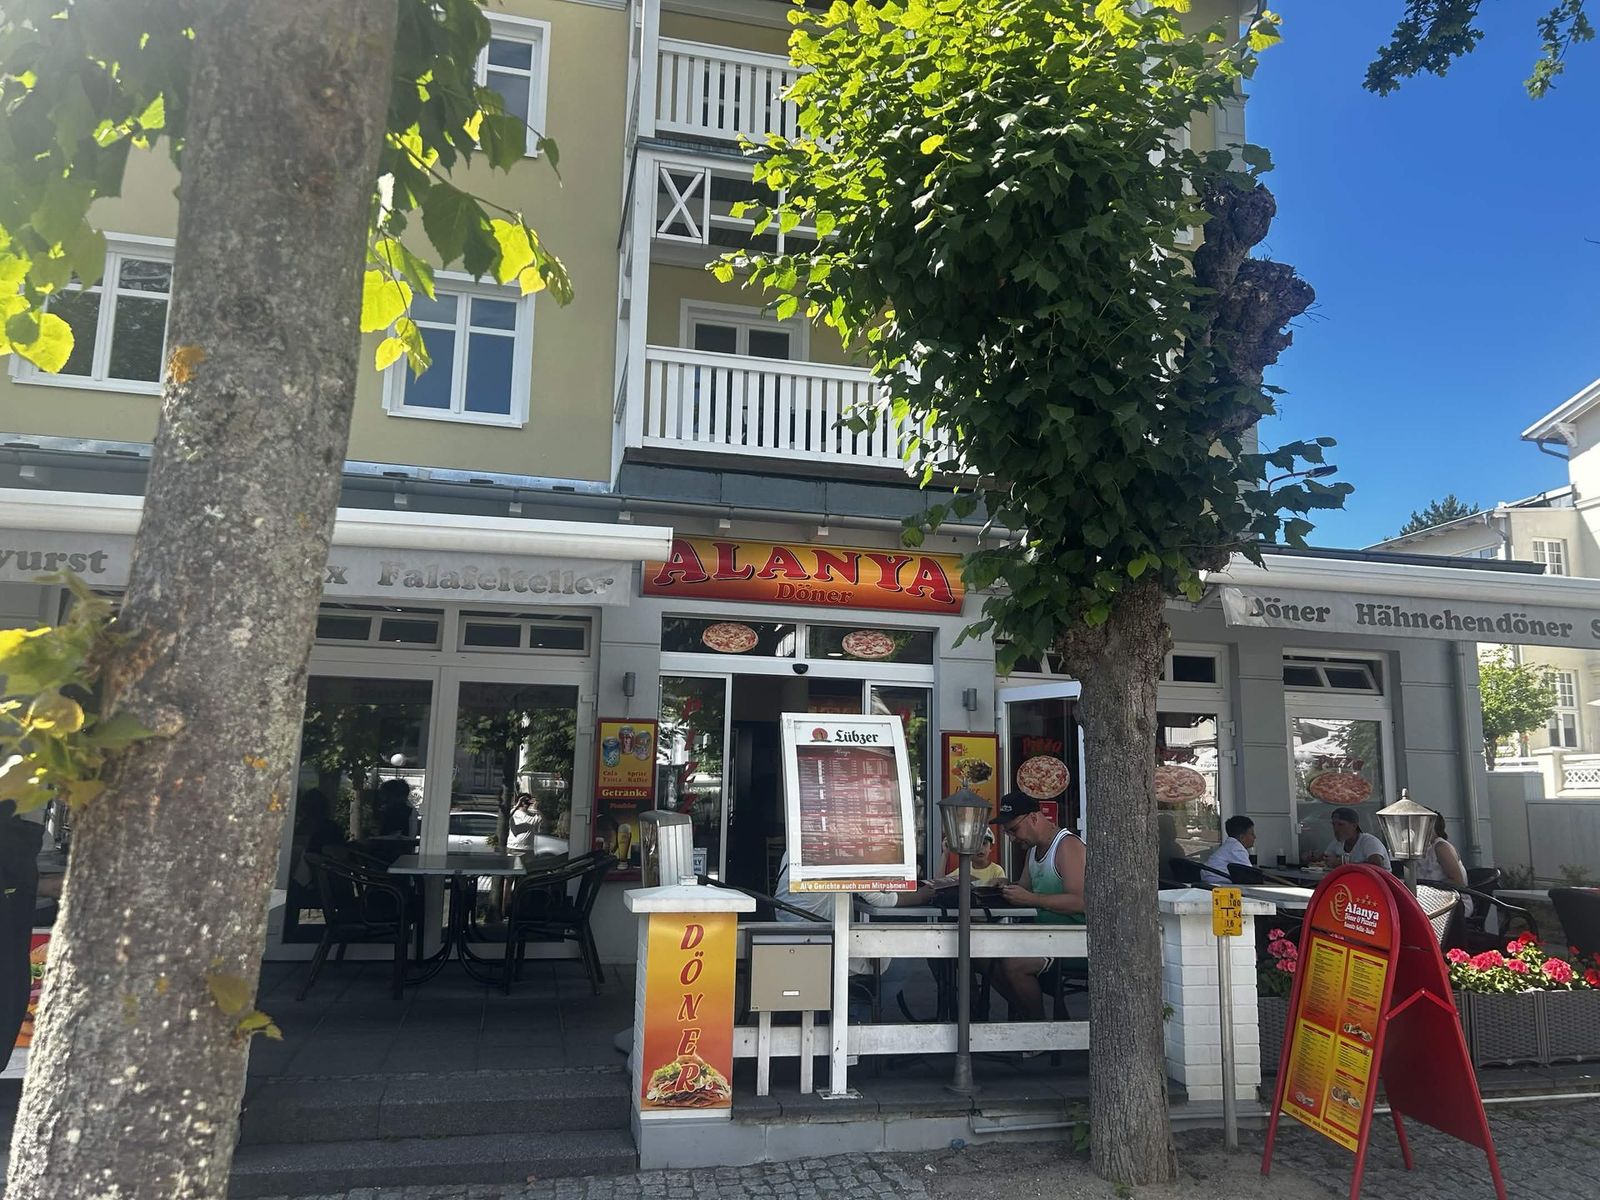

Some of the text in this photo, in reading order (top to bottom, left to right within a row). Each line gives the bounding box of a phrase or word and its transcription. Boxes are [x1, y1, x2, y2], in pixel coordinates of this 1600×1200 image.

[652, 538, 955, 604] ALANYA
[775, 582, 854, 604] Döner
[1355, 603, 1574, 638] Hähnchendöner
[834, 729, 879, 745] Lübzer
[814, 882, 841, 890] Gerichte
[1344, 902, 1379, 921] Alanya
[676, 924, 705, 1092] DÖNER
